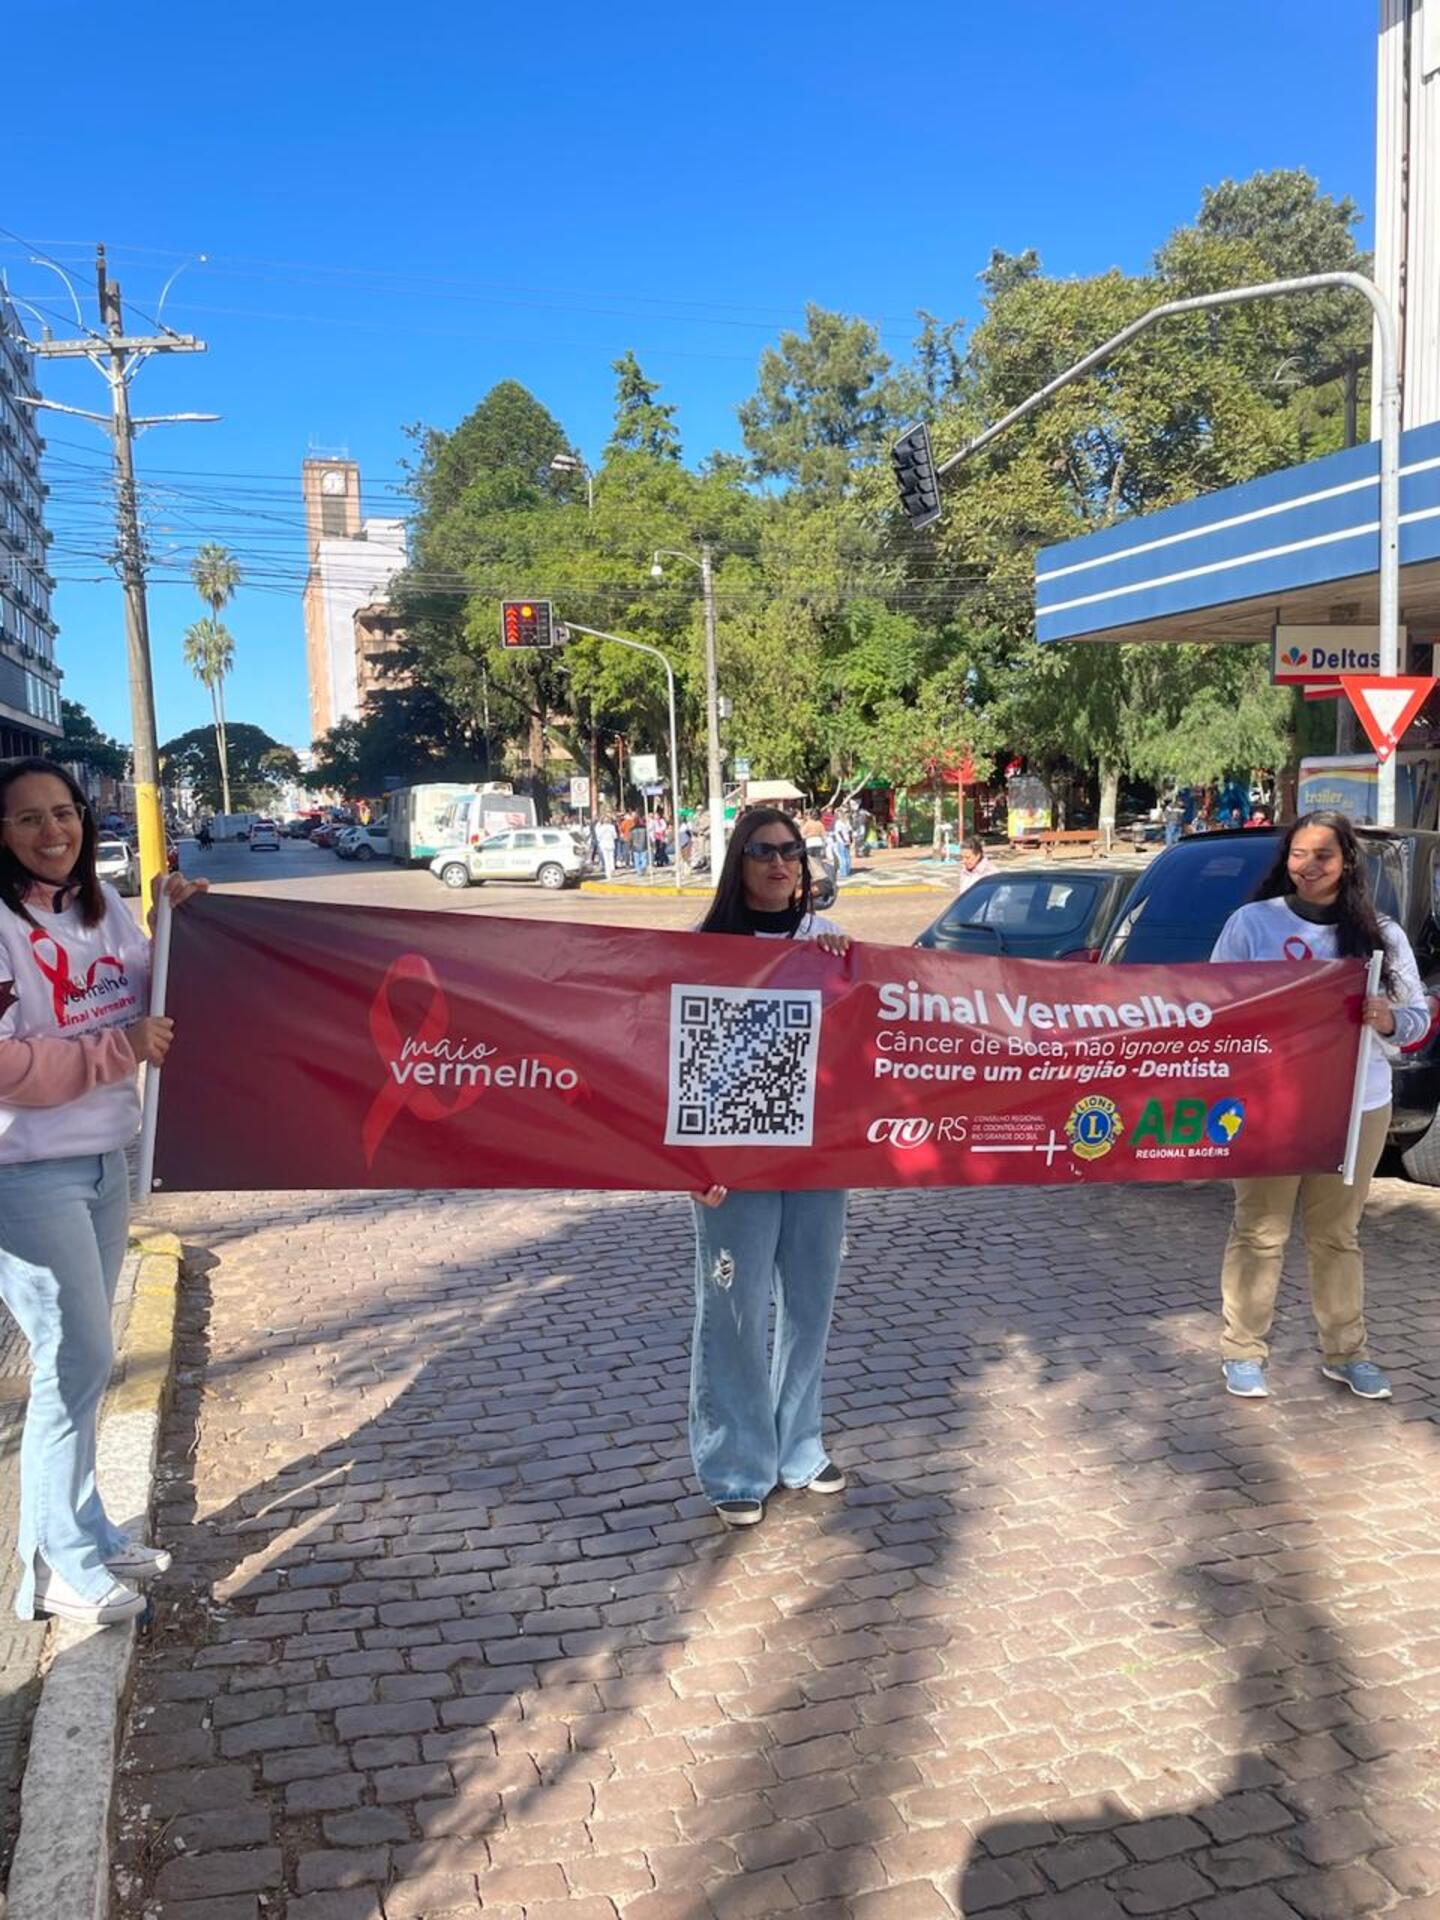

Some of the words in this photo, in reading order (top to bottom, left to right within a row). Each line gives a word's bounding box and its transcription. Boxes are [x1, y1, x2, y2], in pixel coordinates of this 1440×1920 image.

[1312, 648, 1401, 669] Deltasl
[877, 980, 989, 1025] Sinal
[996, 994, 1213, 1029] Vermelho
[876, 1031, 964, 1053] Câncer
[970, 1033, 1000, 1055] de
[1008, 1036, 1068, 1059] Boca,
[1074, 1037, 1115, 1057] não
[1119, 1036, 1184, 1059] ignore
[1187, 1039, 1210, 1054] os
[390, 1058, 579, 1090] vermelho
[874, 1057, 977, 1081] Procure
[983, 1064, 1022, 1081] um
[1028, 1060, 1127, 1083] cirurgião
[1078, 1097, 1114, 1111] LIONS
[937, 1115, 970, 1142] RS
[1087, 1115, 1103, 1138] L
[1135, 1148, 1186, 1159] REGIONAL
